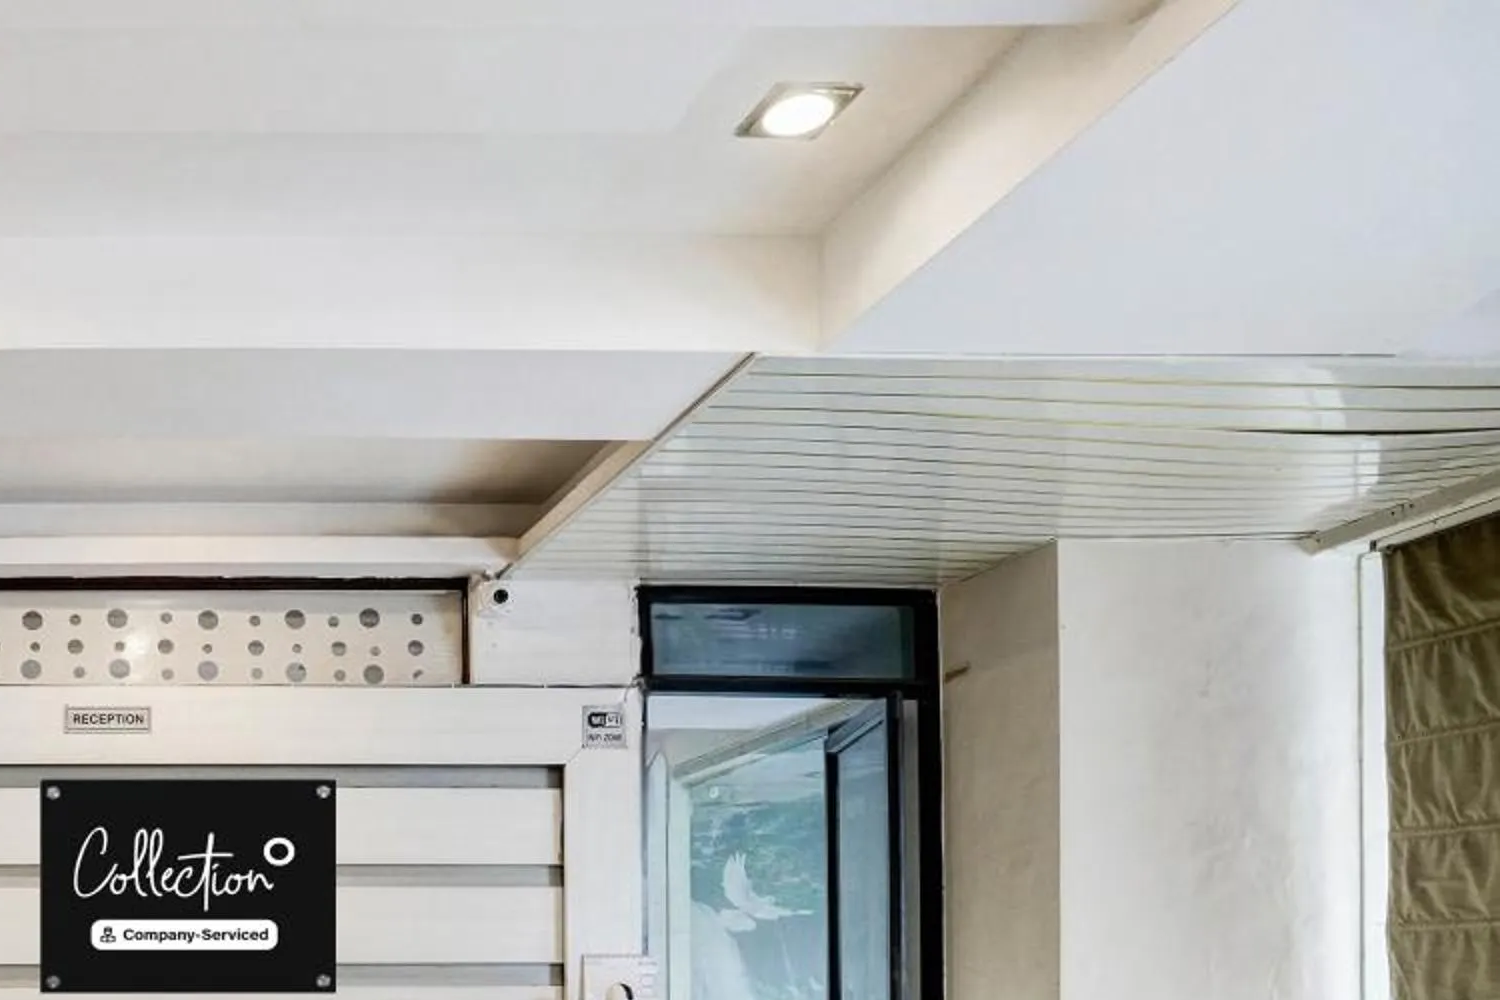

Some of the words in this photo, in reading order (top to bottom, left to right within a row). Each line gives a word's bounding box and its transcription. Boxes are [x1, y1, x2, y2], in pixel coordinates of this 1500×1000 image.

[72, 713, 145, 725] RECEPTION
[73, 826, 274, 912] Collection
[122, 928, 270, 944] Company-Serviced
